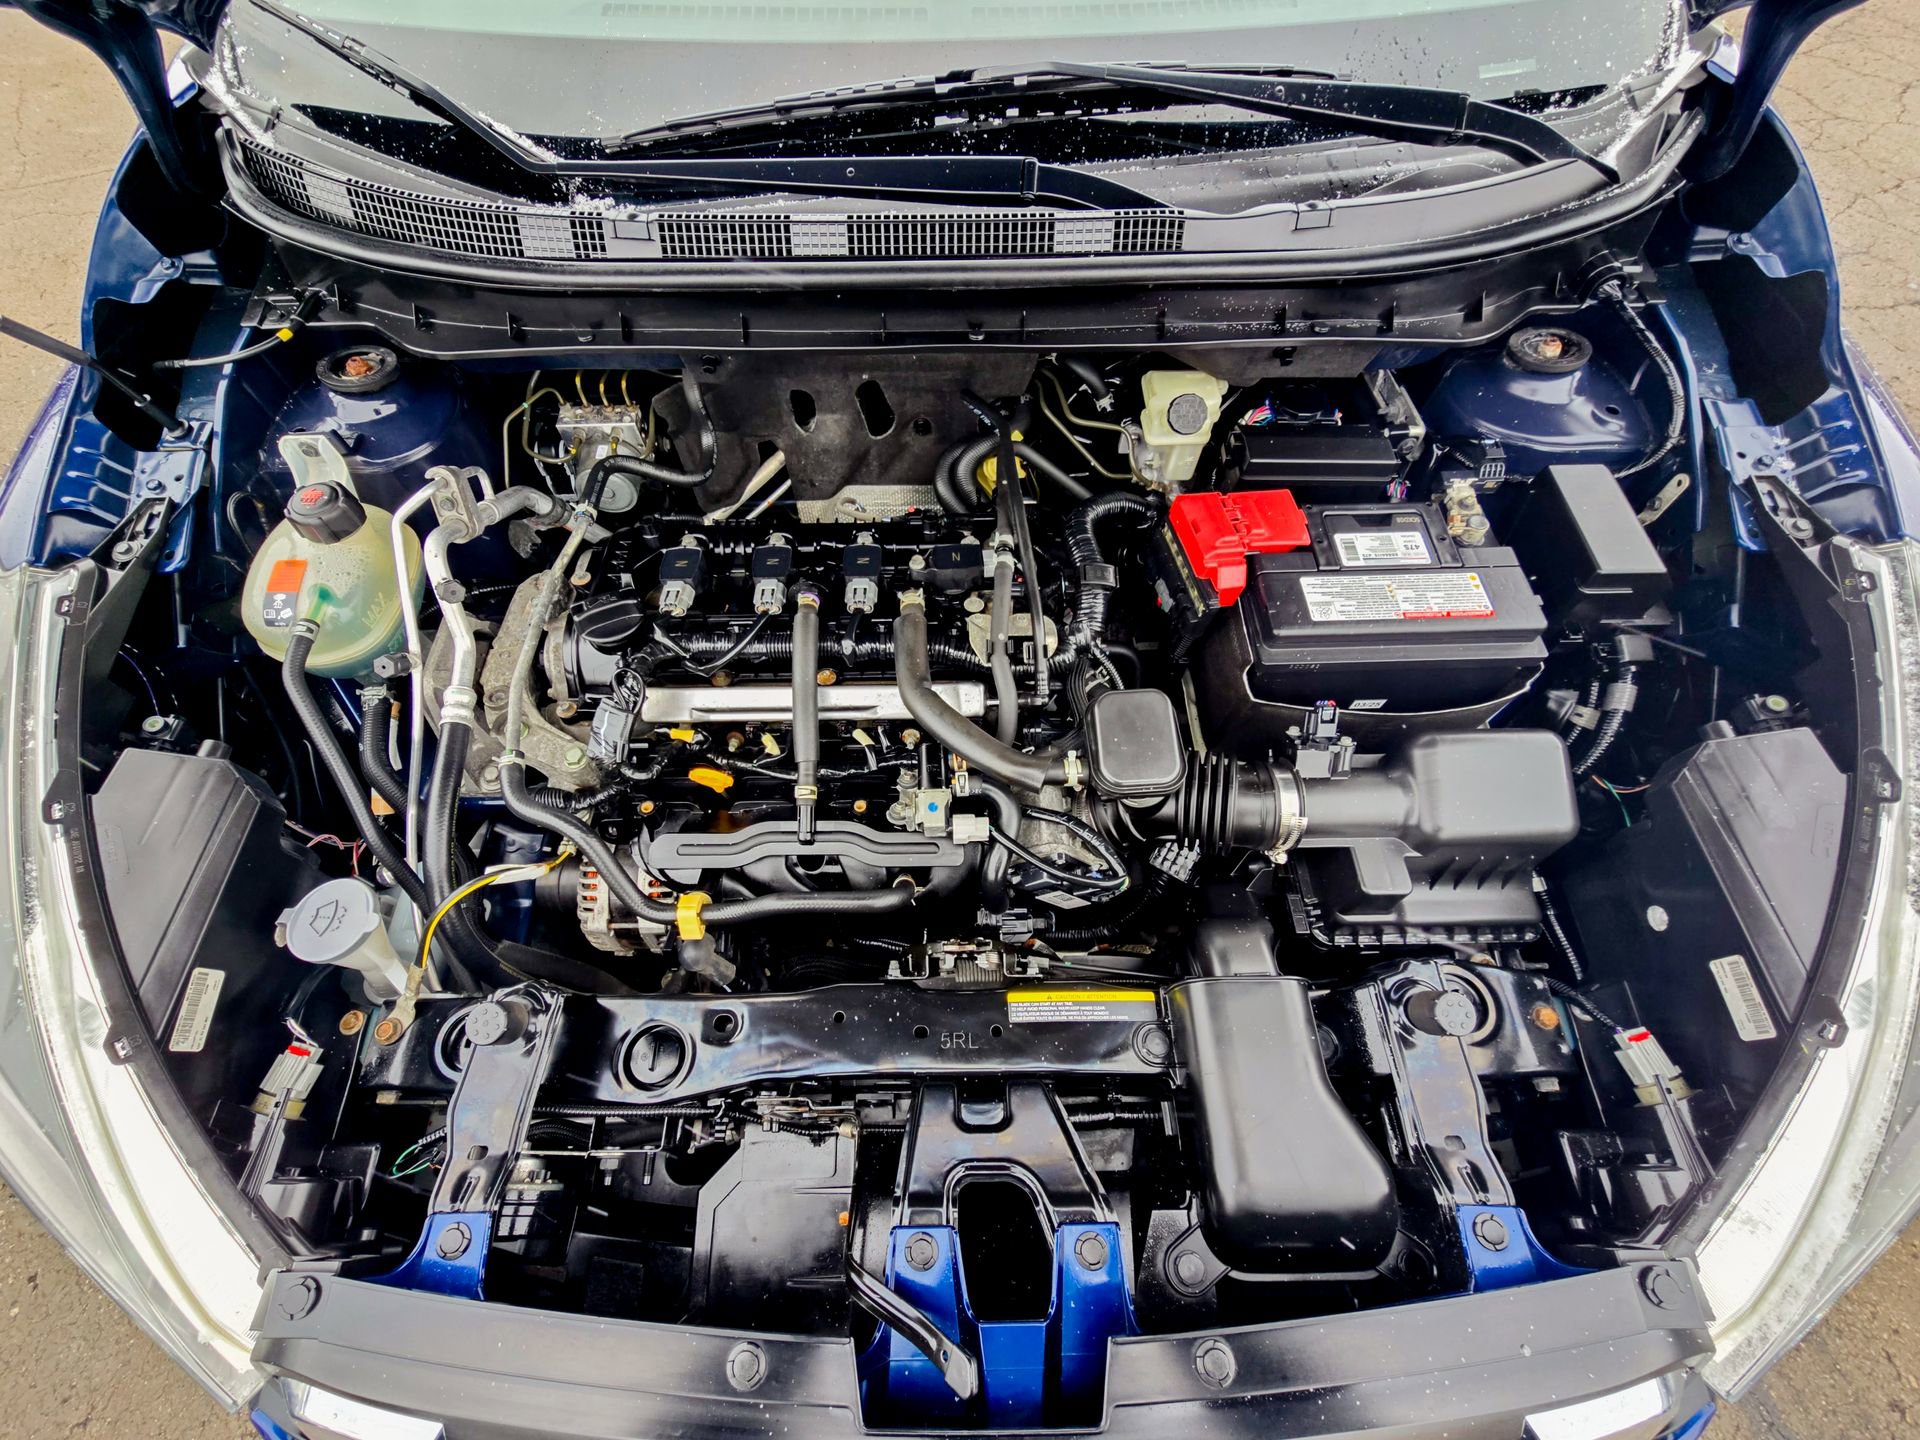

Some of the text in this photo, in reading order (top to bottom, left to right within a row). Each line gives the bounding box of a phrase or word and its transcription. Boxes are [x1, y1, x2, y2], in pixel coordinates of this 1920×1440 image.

[951, 551, 961, 561] N
[361, 591, 387, 629] MAX
[940, 1032, 979, 1049] 5RL
